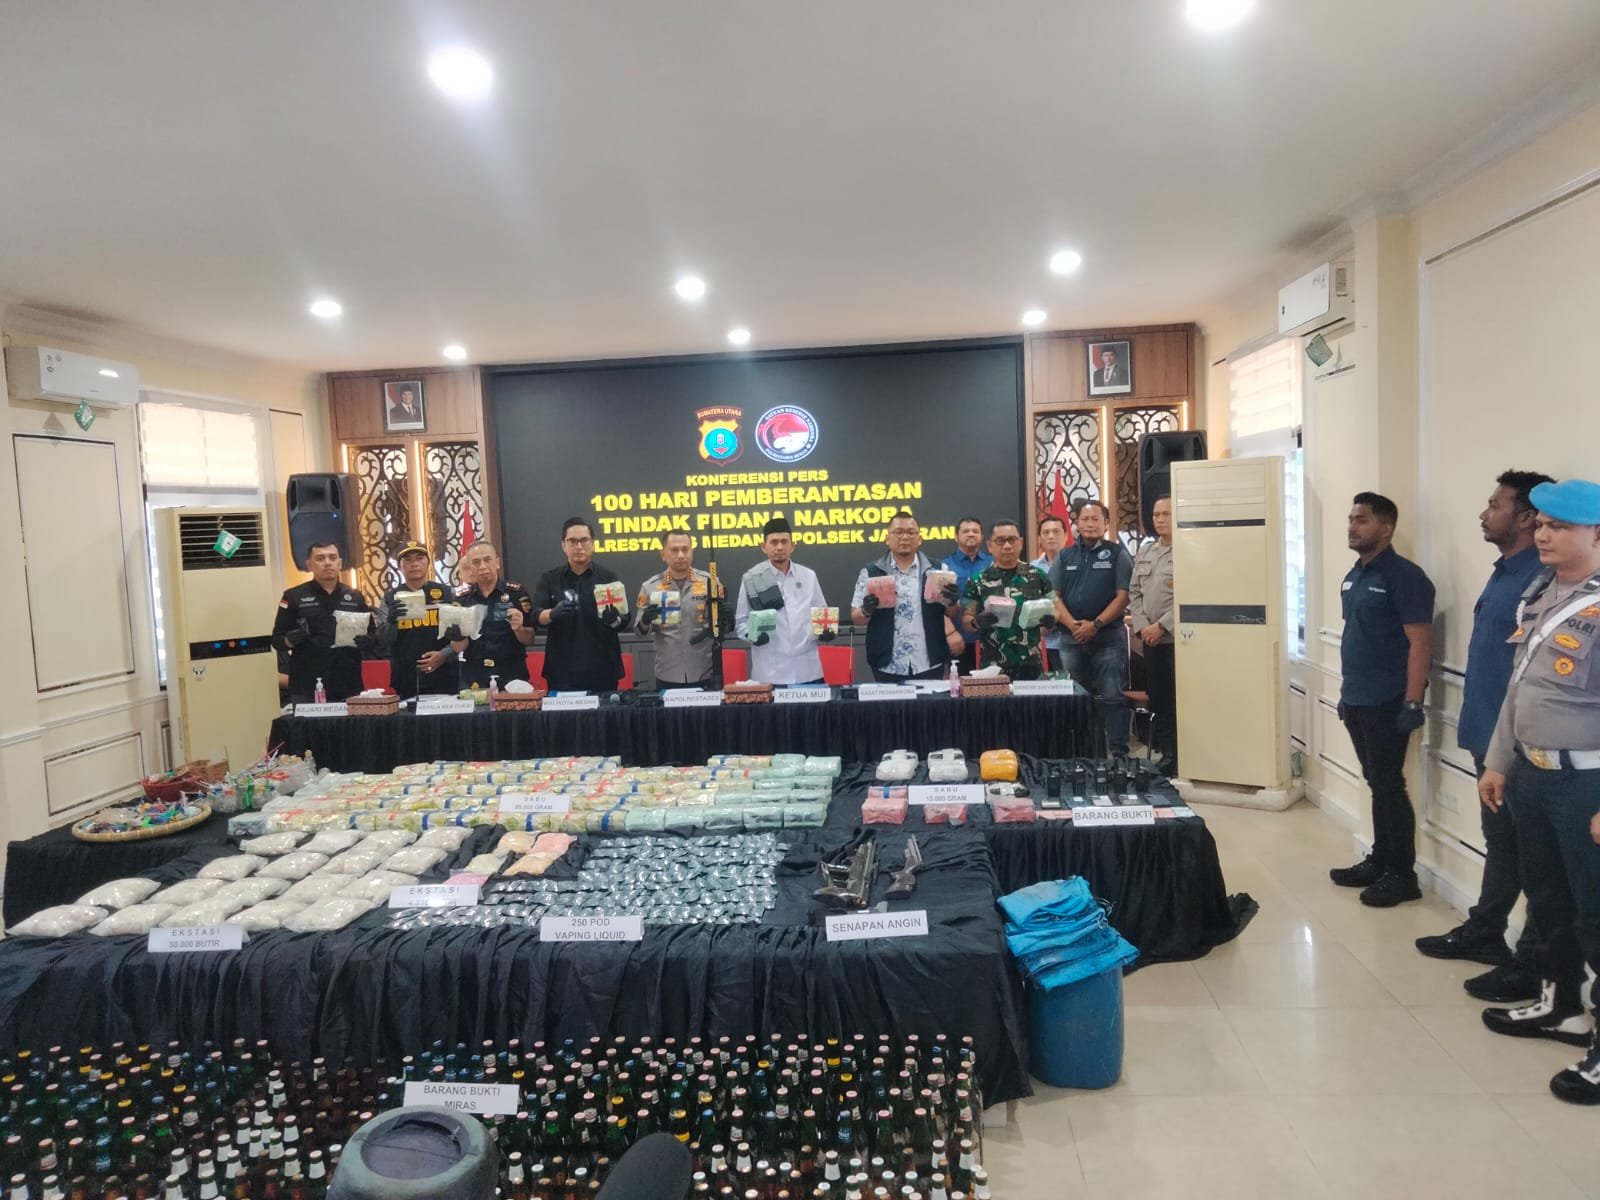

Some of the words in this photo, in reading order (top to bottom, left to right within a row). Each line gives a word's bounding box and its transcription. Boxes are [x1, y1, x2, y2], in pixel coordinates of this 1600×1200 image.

[686, 472, 783, 486] KONFERENSI
[788, 470, 828, 482] PERS
[591, 494, 633, 511] 100
[640, 491, 698, 509] HARI
[705, 481, 922, 507] PEMBERANTASAN
[599, 514, 691, 534] TINDAK
[792, 530, 864, 545] POLSEK
[1563, 618, 1596, 634] OLRI
[779, 691, 808, 699] KETUA
[1074, 810, 1119, 820] BARANG
[1121, 810, 1153, 819] BUKTI
[409, 886, 460, 895] EKSTASI
[571, 918, 587, 927] 250
[590, 918, 610, 927] POD
[832, 921, 884, 933] SENAPAN
[887, 918, 921, 929] ANGIN
[172, 927, 220, 937] EKSTASI
[555, 931, 591, 940] VAPING
[593, 931, 625, 940] LIQUID
[195, 939, 221, 947] BUTIR
[423, 1084, 467, 1095] BARANG
[470, 1086, 500, 1096] BUKTI
[444, 1100, 477, 1110] MIRAS
